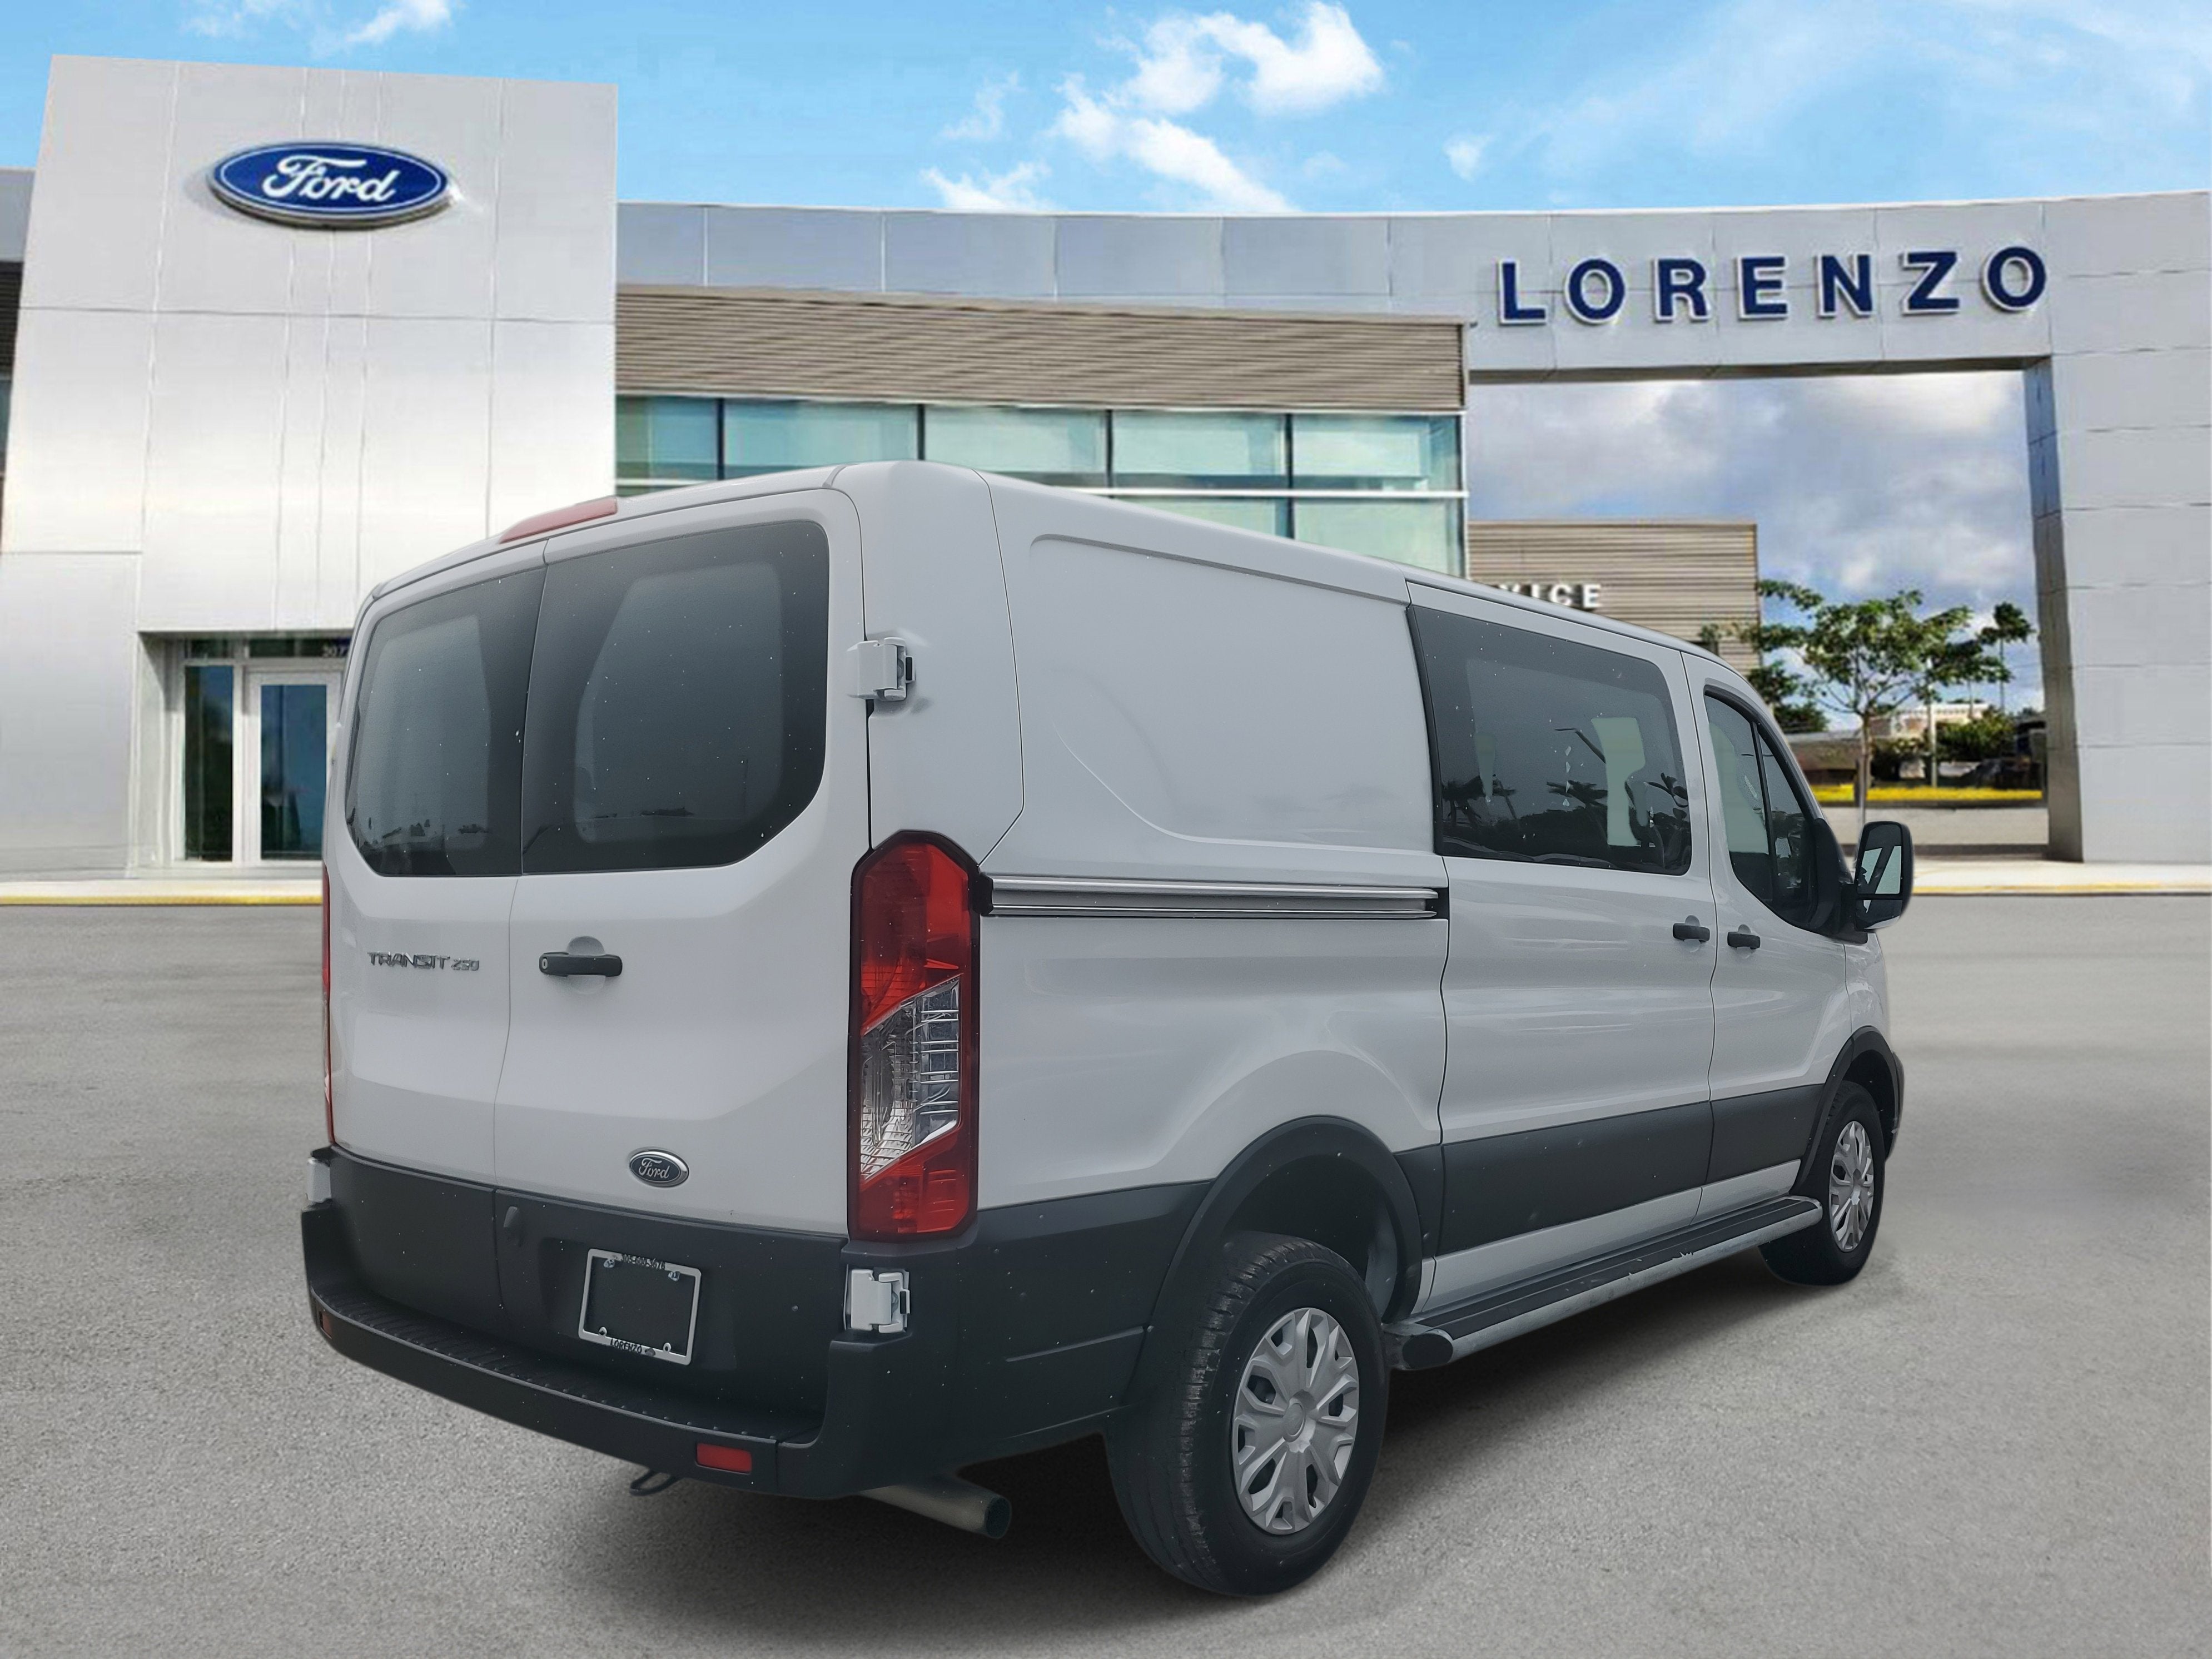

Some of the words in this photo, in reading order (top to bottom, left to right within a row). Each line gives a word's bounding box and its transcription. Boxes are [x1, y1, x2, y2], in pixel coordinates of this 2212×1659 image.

[262, 155, 401, 201] Ford
[1500, 246, 2047, 325] LORENZO
[1499, 584, 1601, 608] ICE
[367, 951, 450, 970] TRANSIT
[638, 1158, 670, 1179] Ford
[610, 1338, 643, 1354] LORENZO
